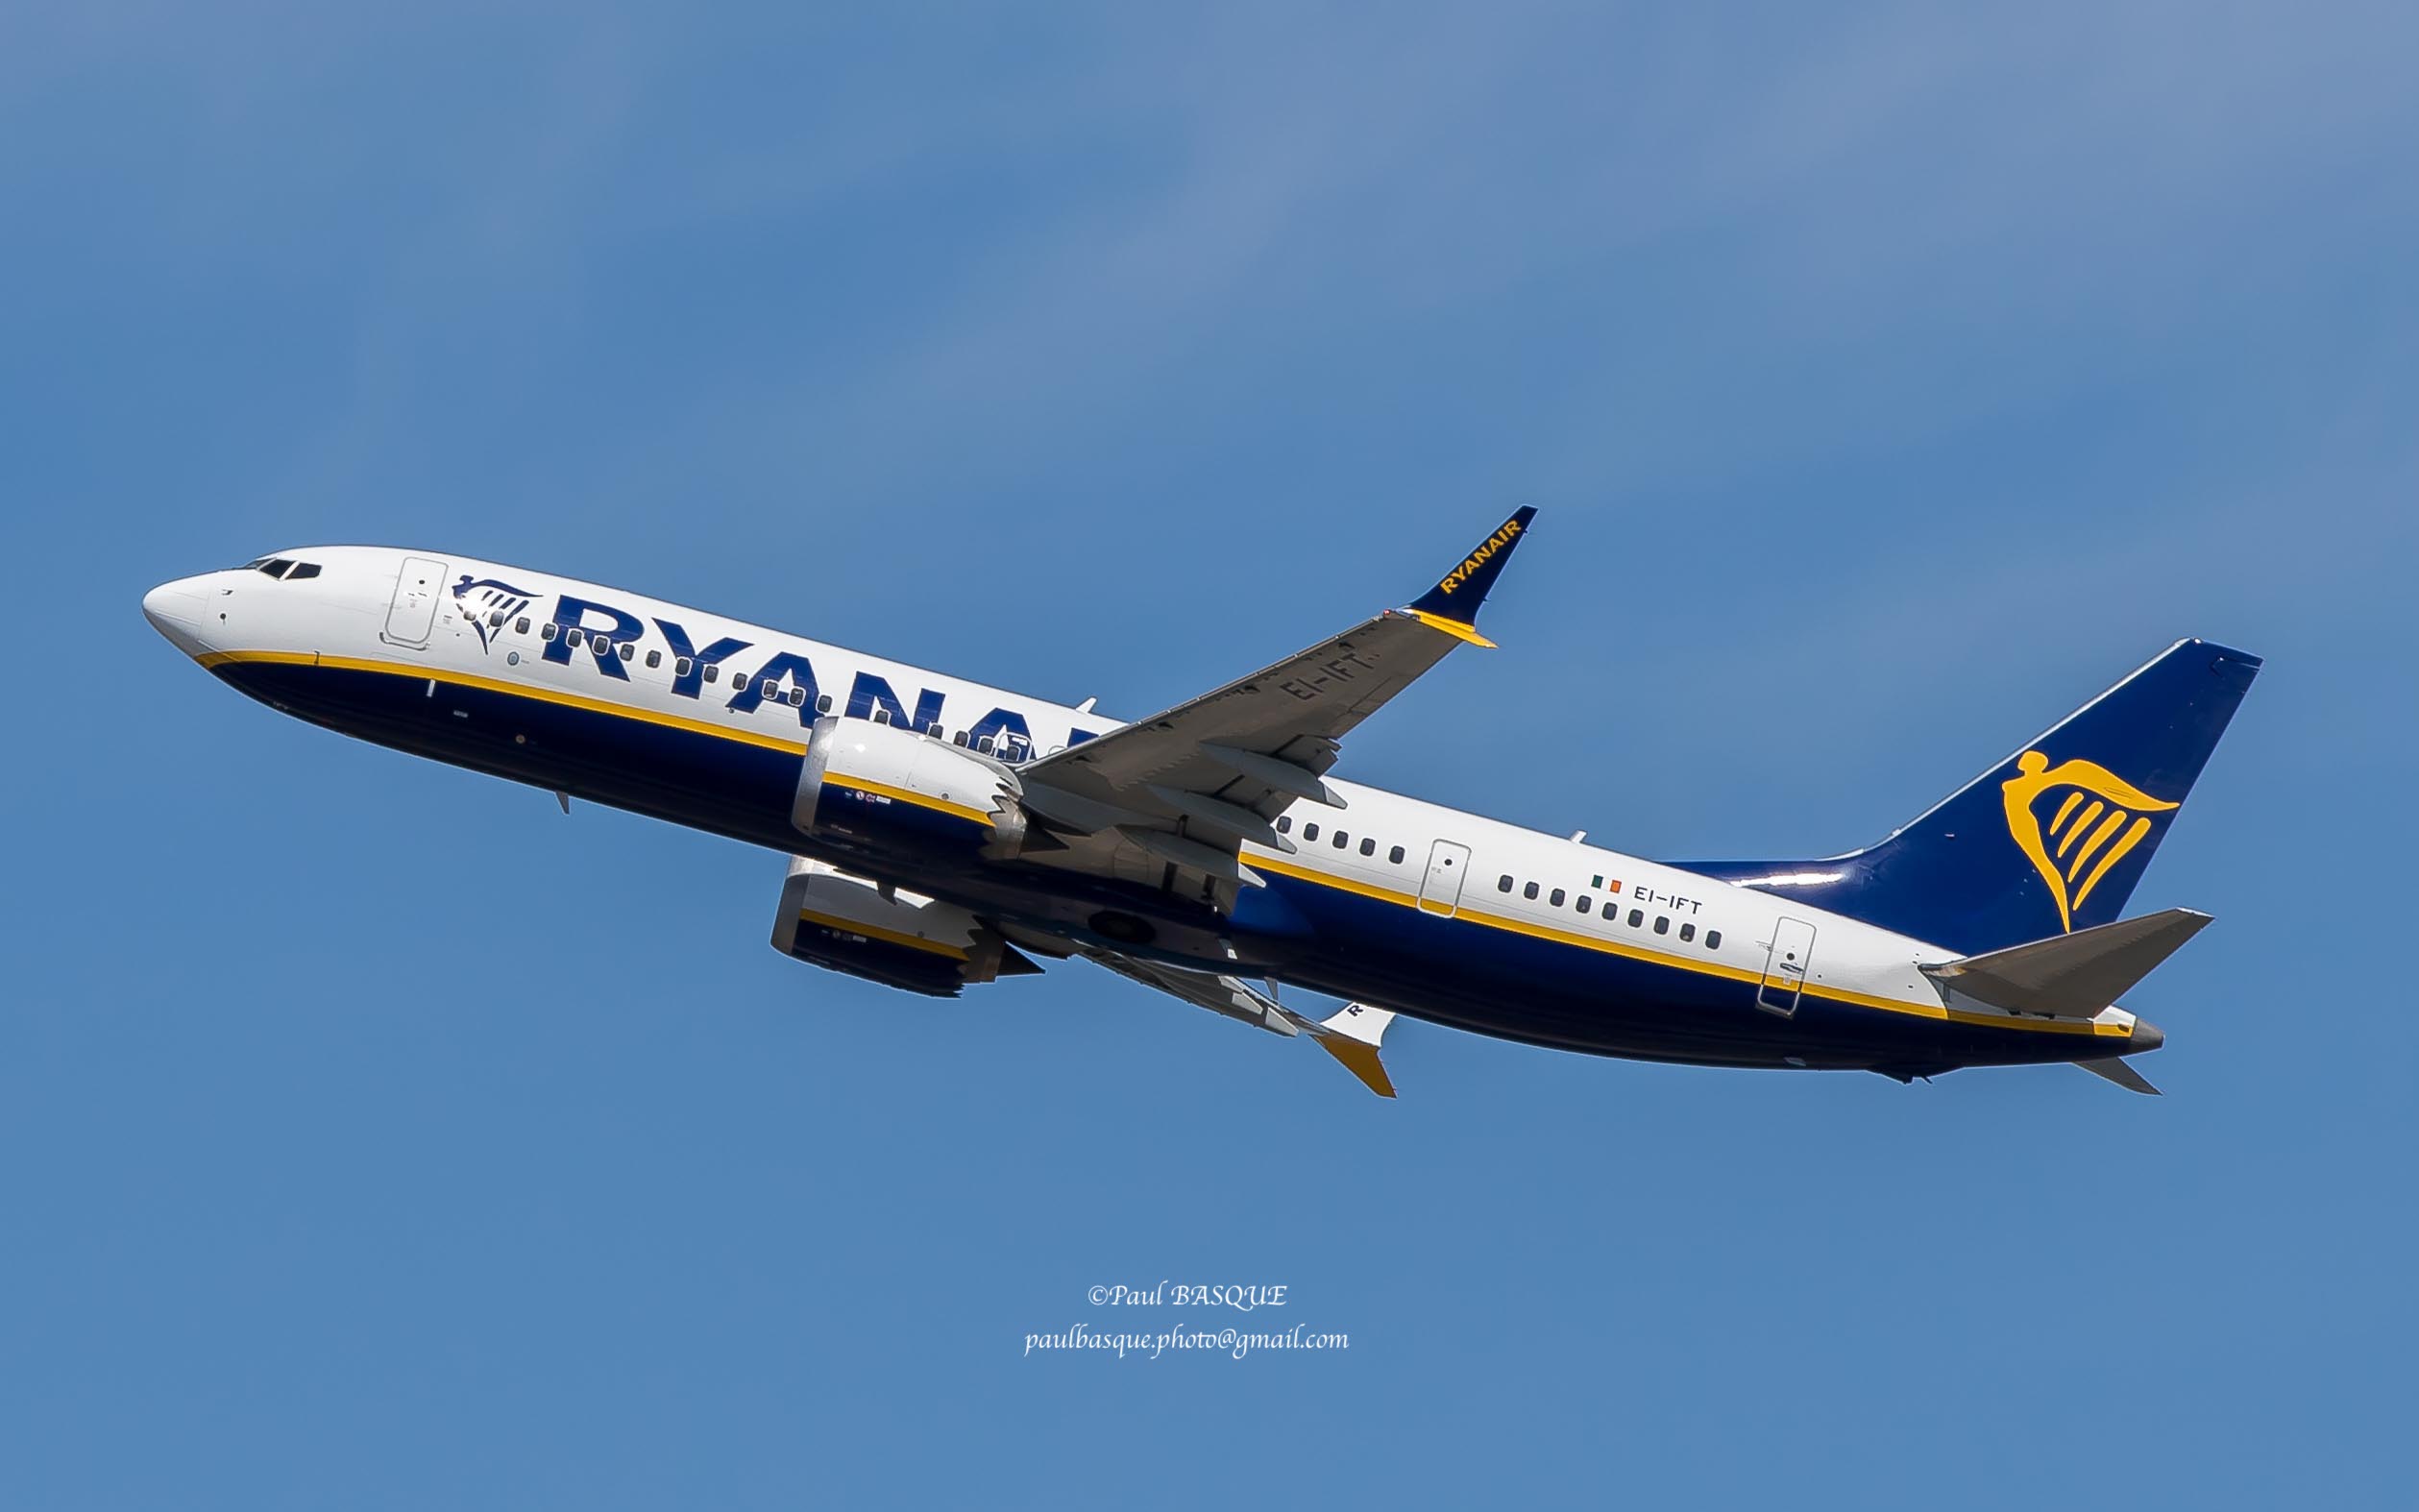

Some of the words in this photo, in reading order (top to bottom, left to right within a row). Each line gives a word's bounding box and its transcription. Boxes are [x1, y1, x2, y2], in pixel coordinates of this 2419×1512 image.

[1440, 520, 1521, 594] RYANAIR
[1280, 652, 1374, 700] EI-IFT
[1633, 887, 1702, 915] EI-IFT
